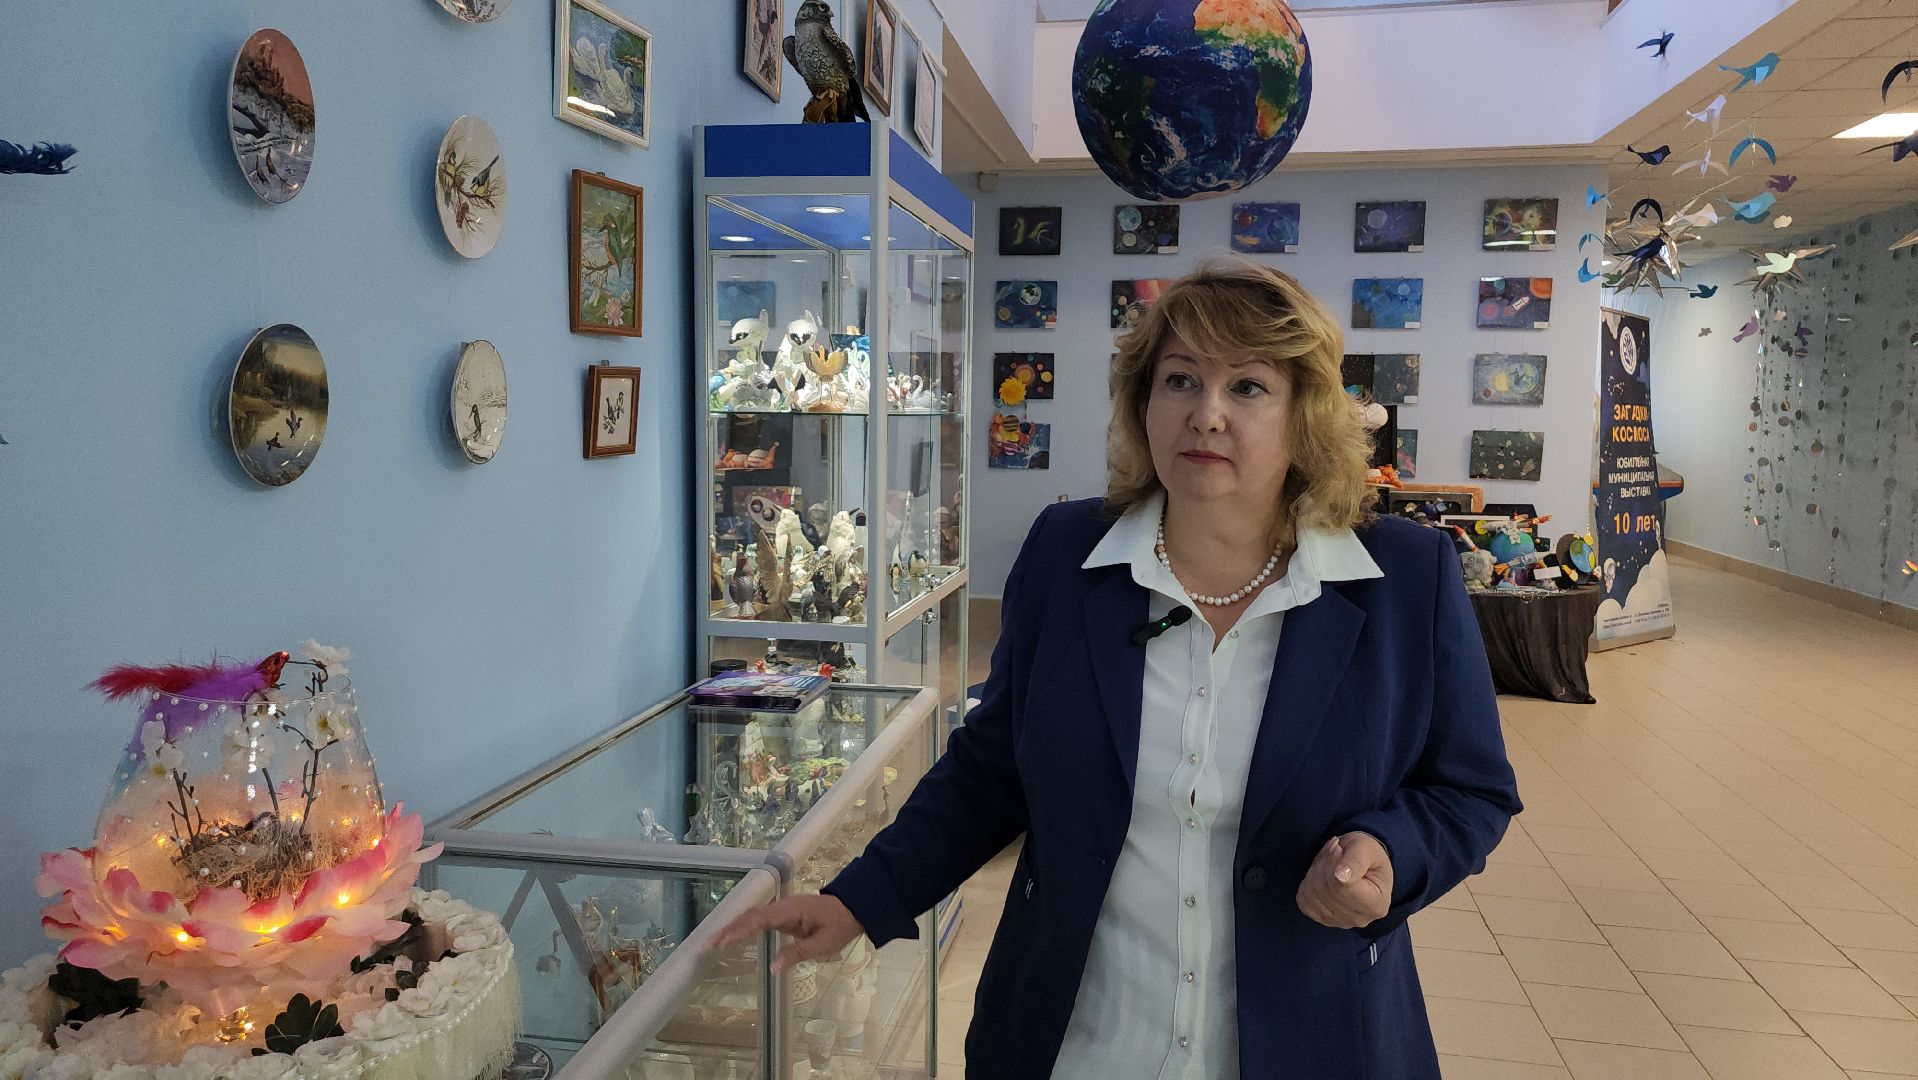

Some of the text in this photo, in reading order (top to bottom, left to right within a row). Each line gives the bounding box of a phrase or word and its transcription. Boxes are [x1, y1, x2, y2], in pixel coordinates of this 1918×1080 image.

[1612, 426, 1650, 442] КОСМОСА
[1613, 511, 1656, 535] 10 лет
